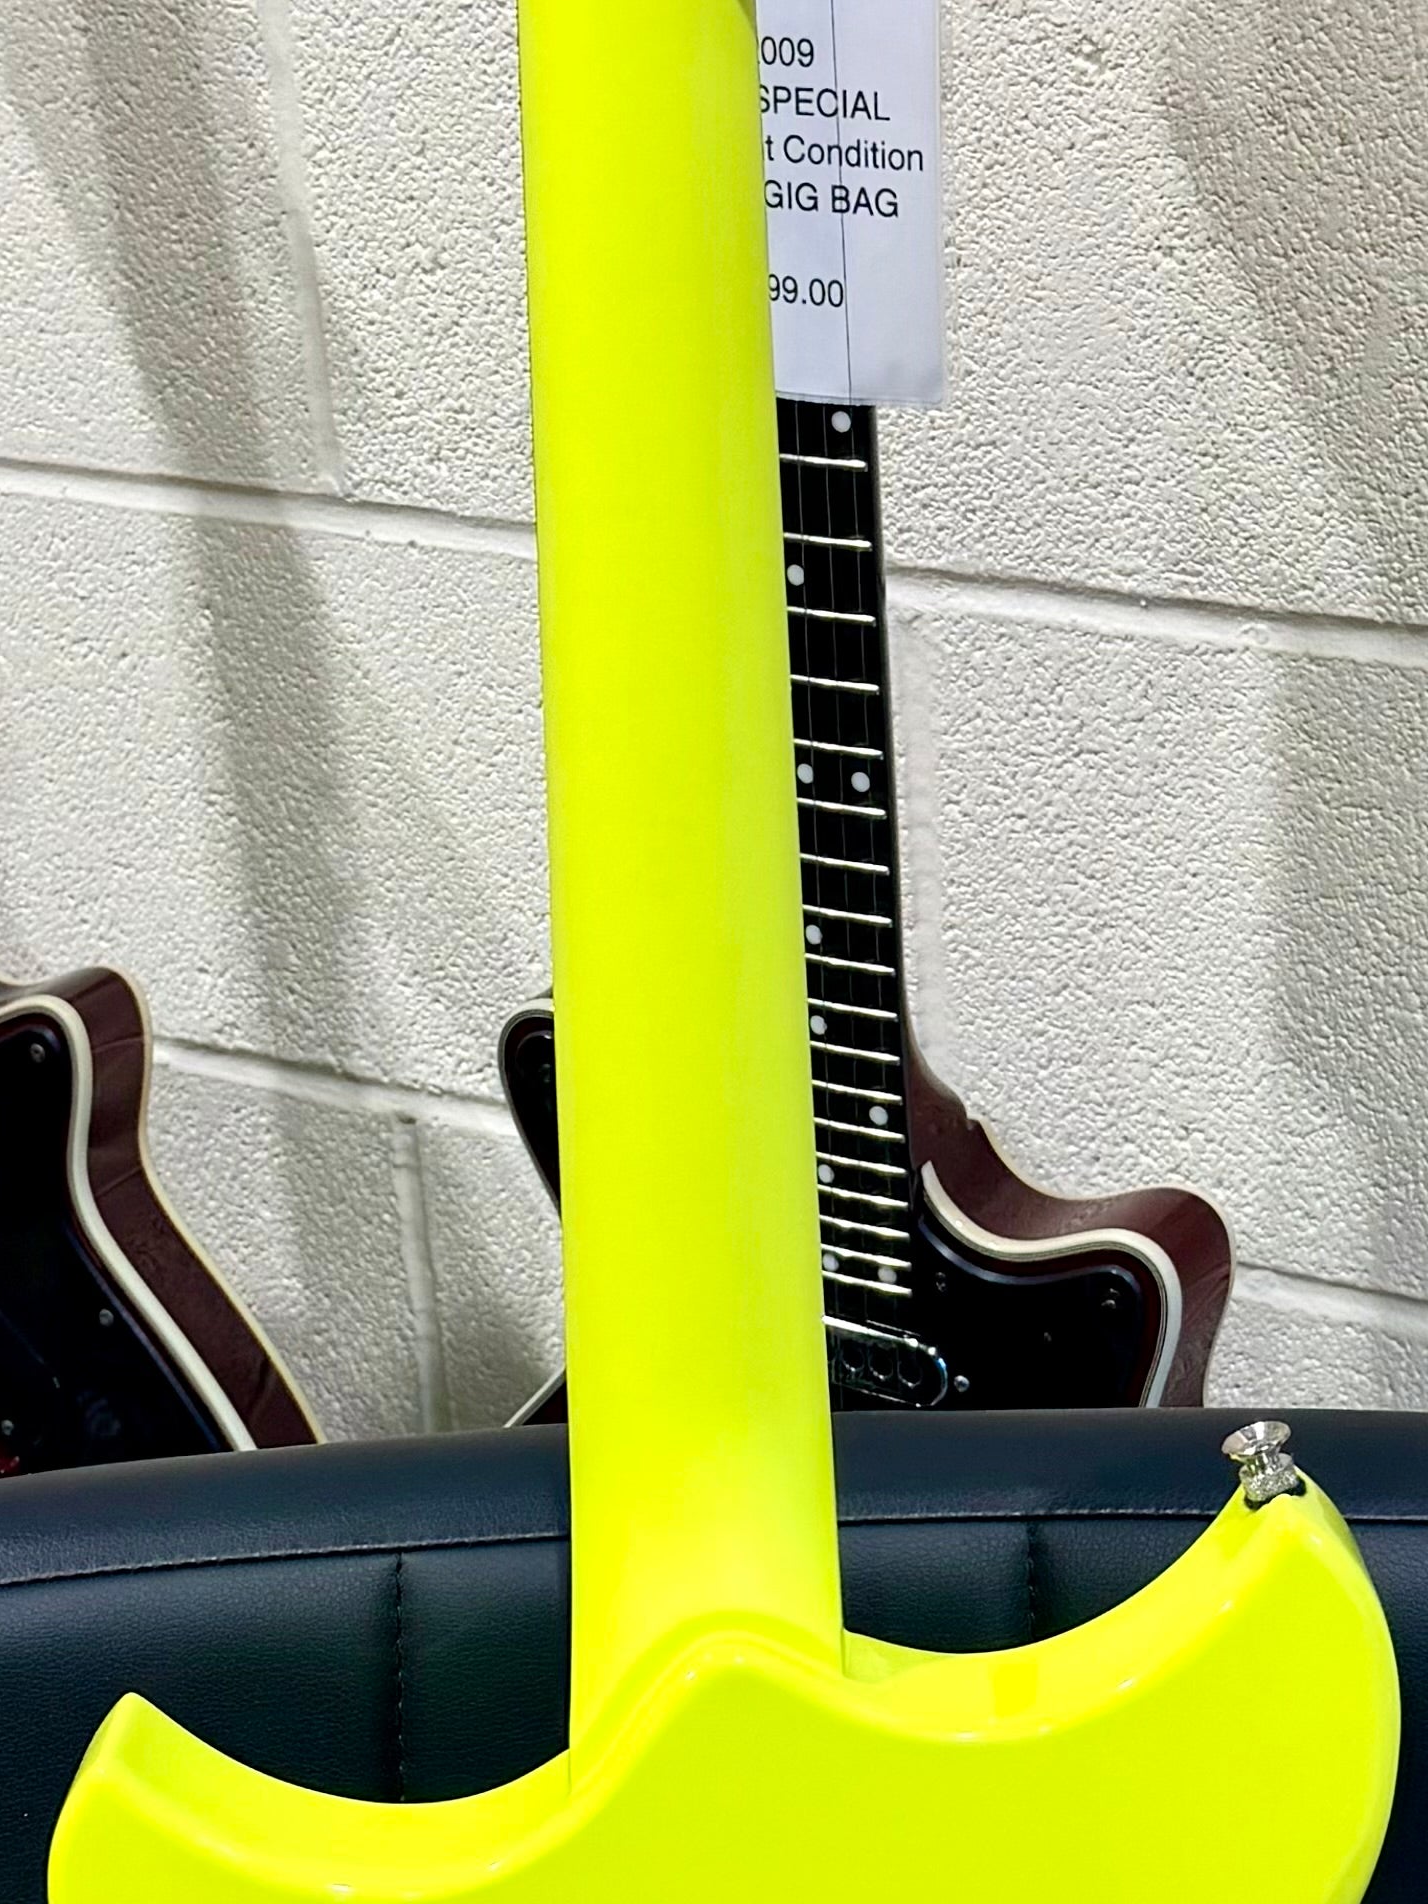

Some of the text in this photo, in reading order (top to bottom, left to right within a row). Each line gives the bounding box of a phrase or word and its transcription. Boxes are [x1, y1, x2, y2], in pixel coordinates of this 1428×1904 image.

[758, 36, 815, 68] 009
[759, 84, 891, 122] SPECIAL
[783, 134, 924, 172] Condition
[763, 180, 899, 218] GIG BAG
[767, 273, 844, 308] 99.00
